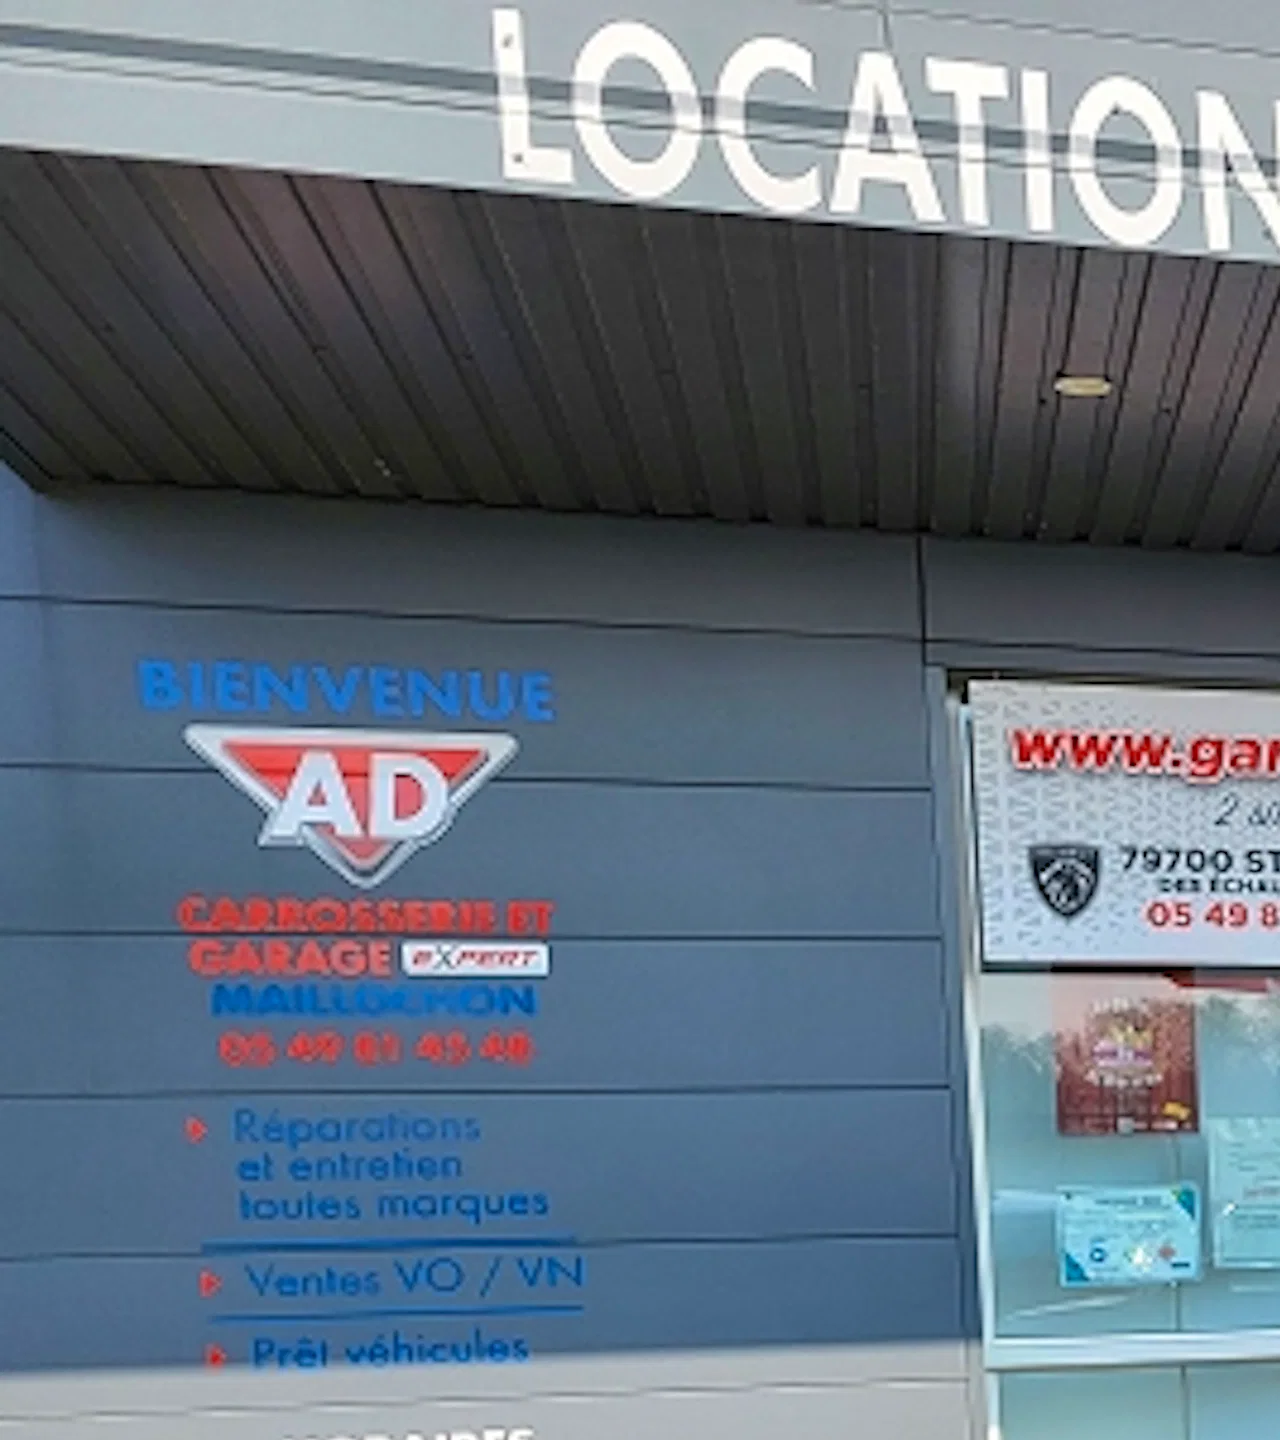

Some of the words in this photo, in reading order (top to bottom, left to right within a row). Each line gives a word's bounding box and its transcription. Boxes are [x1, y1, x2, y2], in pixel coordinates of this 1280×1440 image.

[137, 660, 557, 722] BIENVENUE
[271, 749, 451, 840] AD
[1214, 793, 1239, 826] 2
[1119, 847, 1233, 874] 79700
[177, 897, 494, 935] CARROSSERIE
[507, 900, 557, 935] ET
[1147, 901, 1192, 929] 05
[1205, 902, 1248, 928] 49
[188, 940, 392, 977] GARAGE
[210, 983, 540, 1017] MAILLOCHON
[218, 1030, 276, 1067] 05
[287, 1030, 346, 1065] 49
[233, 1108, 481, 1152] Réparations
[237, 1151, 275, 1181] et
[290, 1148, 464, 1180] entretien
[240, 1191, 362, 1221] toutes
[377, 1191, 550, 1225] marques
[244, 1263, 382, 1297] Ventes
[394, 1257, 465, 1293] VO
[516, 1255, 584, 1289] VN
[252, 1336, 330, 1370] Prêt
[344, 1328, 529, 1367] véhicules
